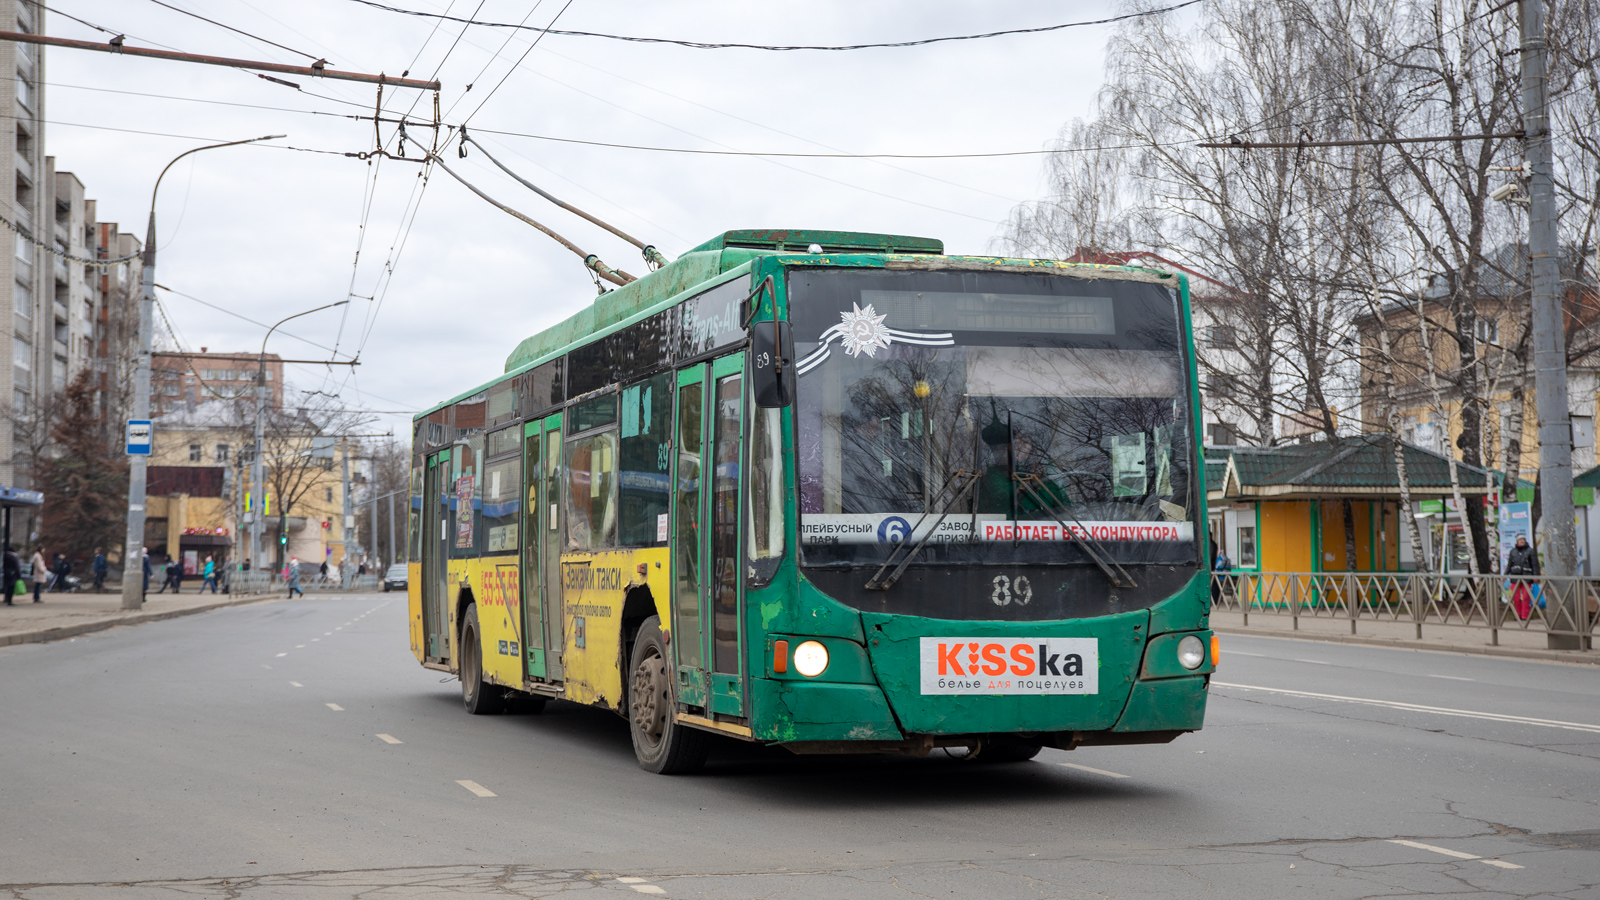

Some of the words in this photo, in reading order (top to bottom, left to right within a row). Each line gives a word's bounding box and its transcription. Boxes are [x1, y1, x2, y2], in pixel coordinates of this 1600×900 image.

[692, 298, 741, 343] Trans-Alf
[757, 351, 770, 369] 89
[657, 442, 669, 470] 89
[885, 520, 904, 544] 6
[986, 525, 1057, 541] РАБОТАЕТ
[1062, 525, 1087, 541] БЕЗ
[1091, 526, 1179, 541] КОНДУКТОРА
[566, 564, 594, 590] Закажи
[596, 568, 621, 590] такси
[991, 574, 1033, 607] 89
[938, 678, 981, 689] белье
[988, 680, 1011, 689] для
[1018, 680, 1084, 691] поцелуев
